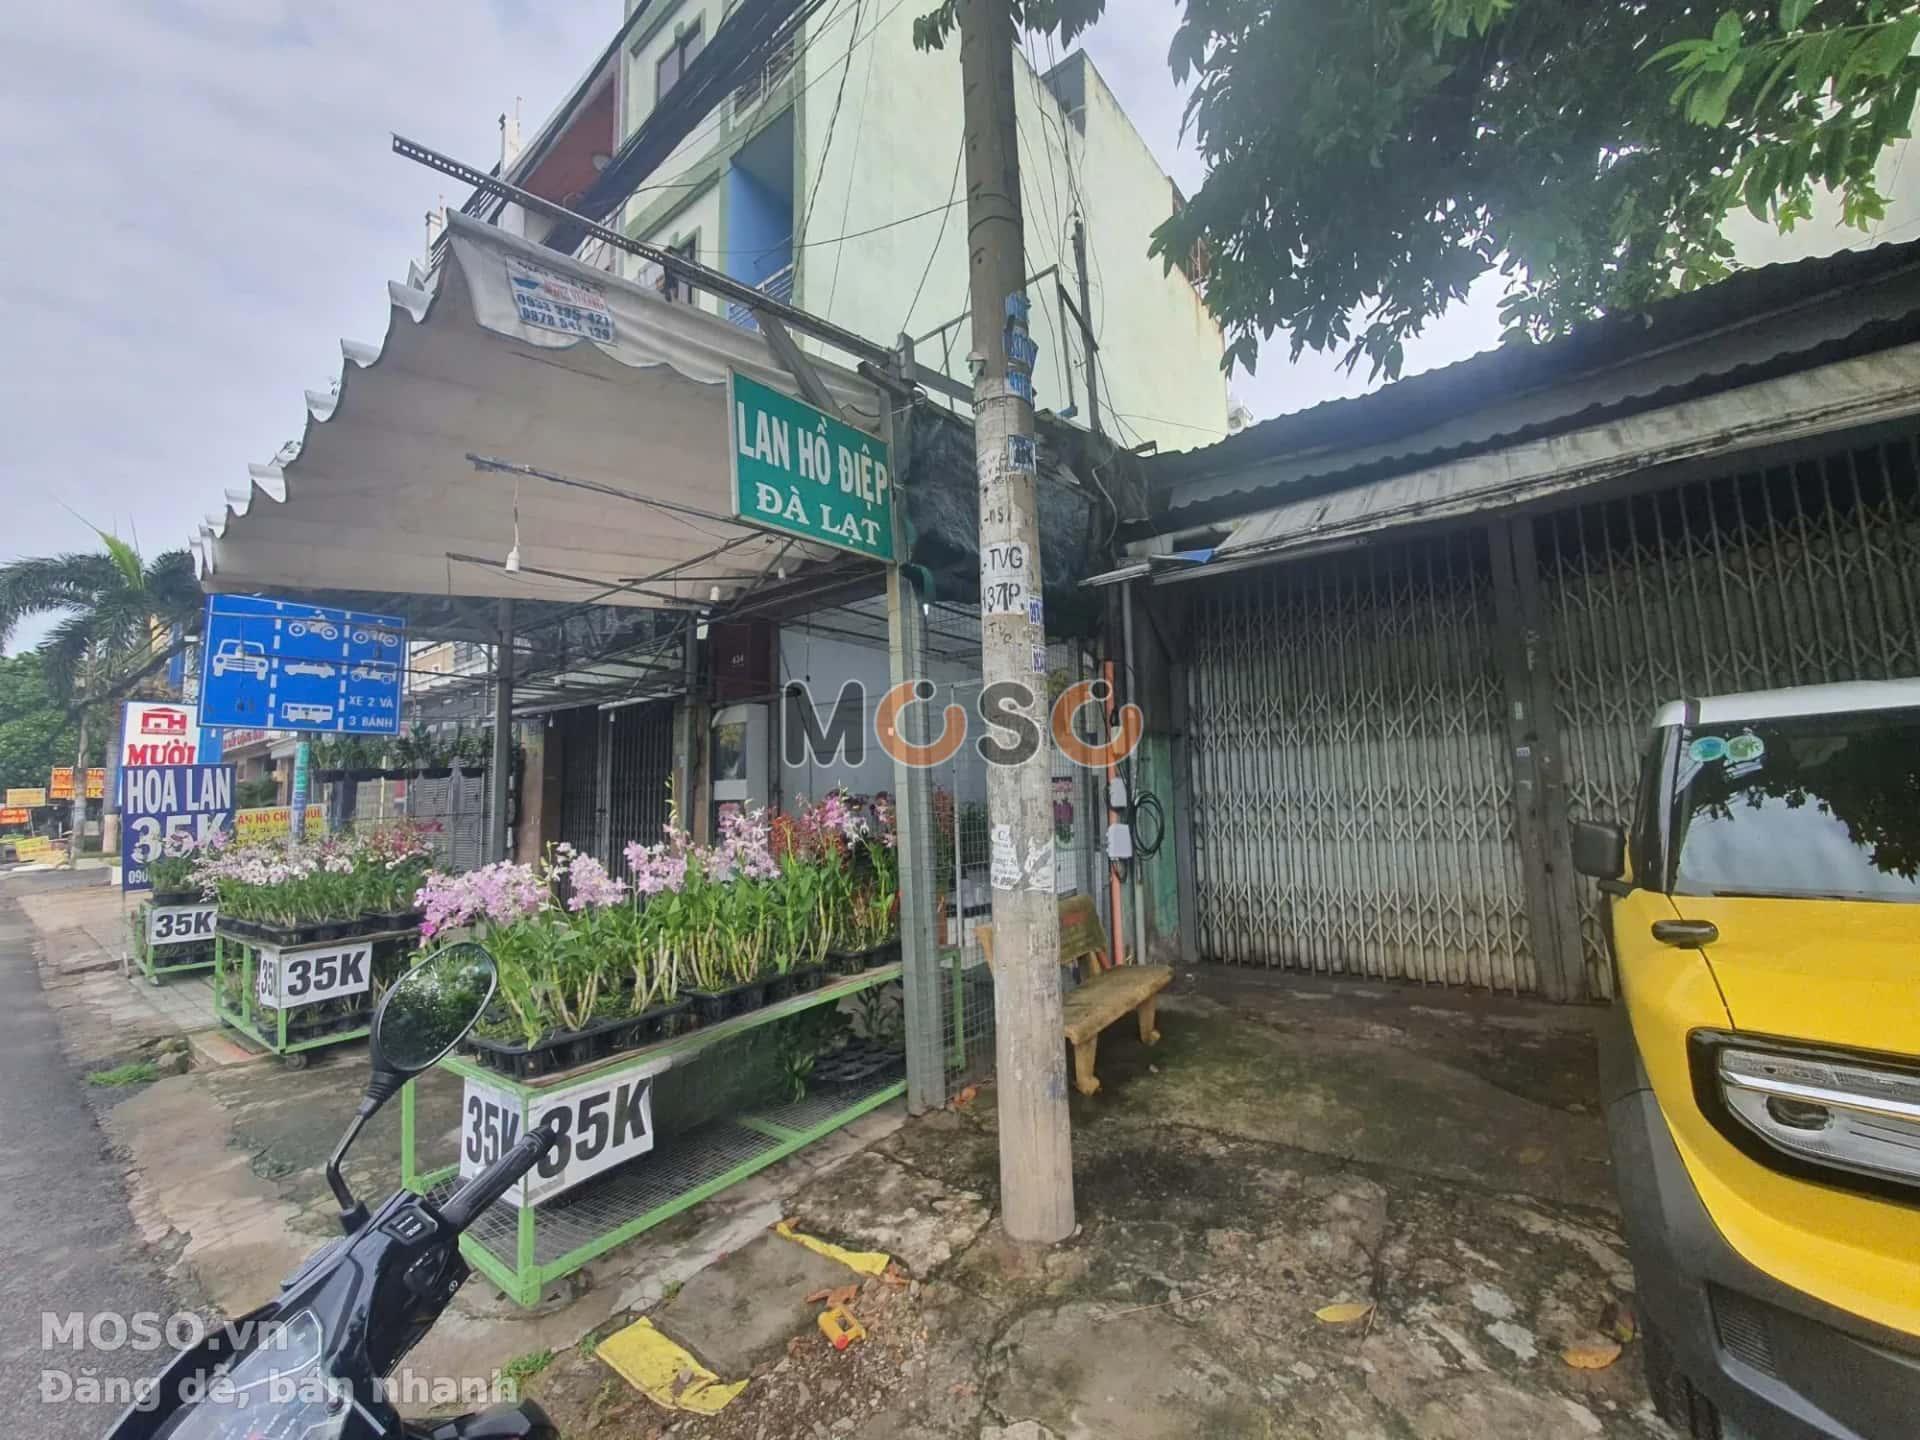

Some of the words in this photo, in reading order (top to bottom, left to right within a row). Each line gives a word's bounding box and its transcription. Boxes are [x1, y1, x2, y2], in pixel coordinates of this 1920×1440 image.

[737, 401, 790, 472] LAN
[797, 416, 832, 486] HỒ
[838, 443, 888, 512] ĐIỆP
[755, 481, 810, 526] ĐÀ
[819, 503, 881, 546] LẠT
[348, 695, 364, 706] XE
[367, 696, 376, 707] 2
[379, 695, 393, 709] VÀ
[348, 715, 357, 726] 3
[361, 713, 393, 729] BÁNH
[127, 738, 196, 766] MƯỜI
[127, 769, 178, 815] HOA
[186, 767, 231, 811] LAN
[130, 812, 228, 864] 35K
[155, 911, 214, 938] 35K
[287, 950, 366, 997] 35K
